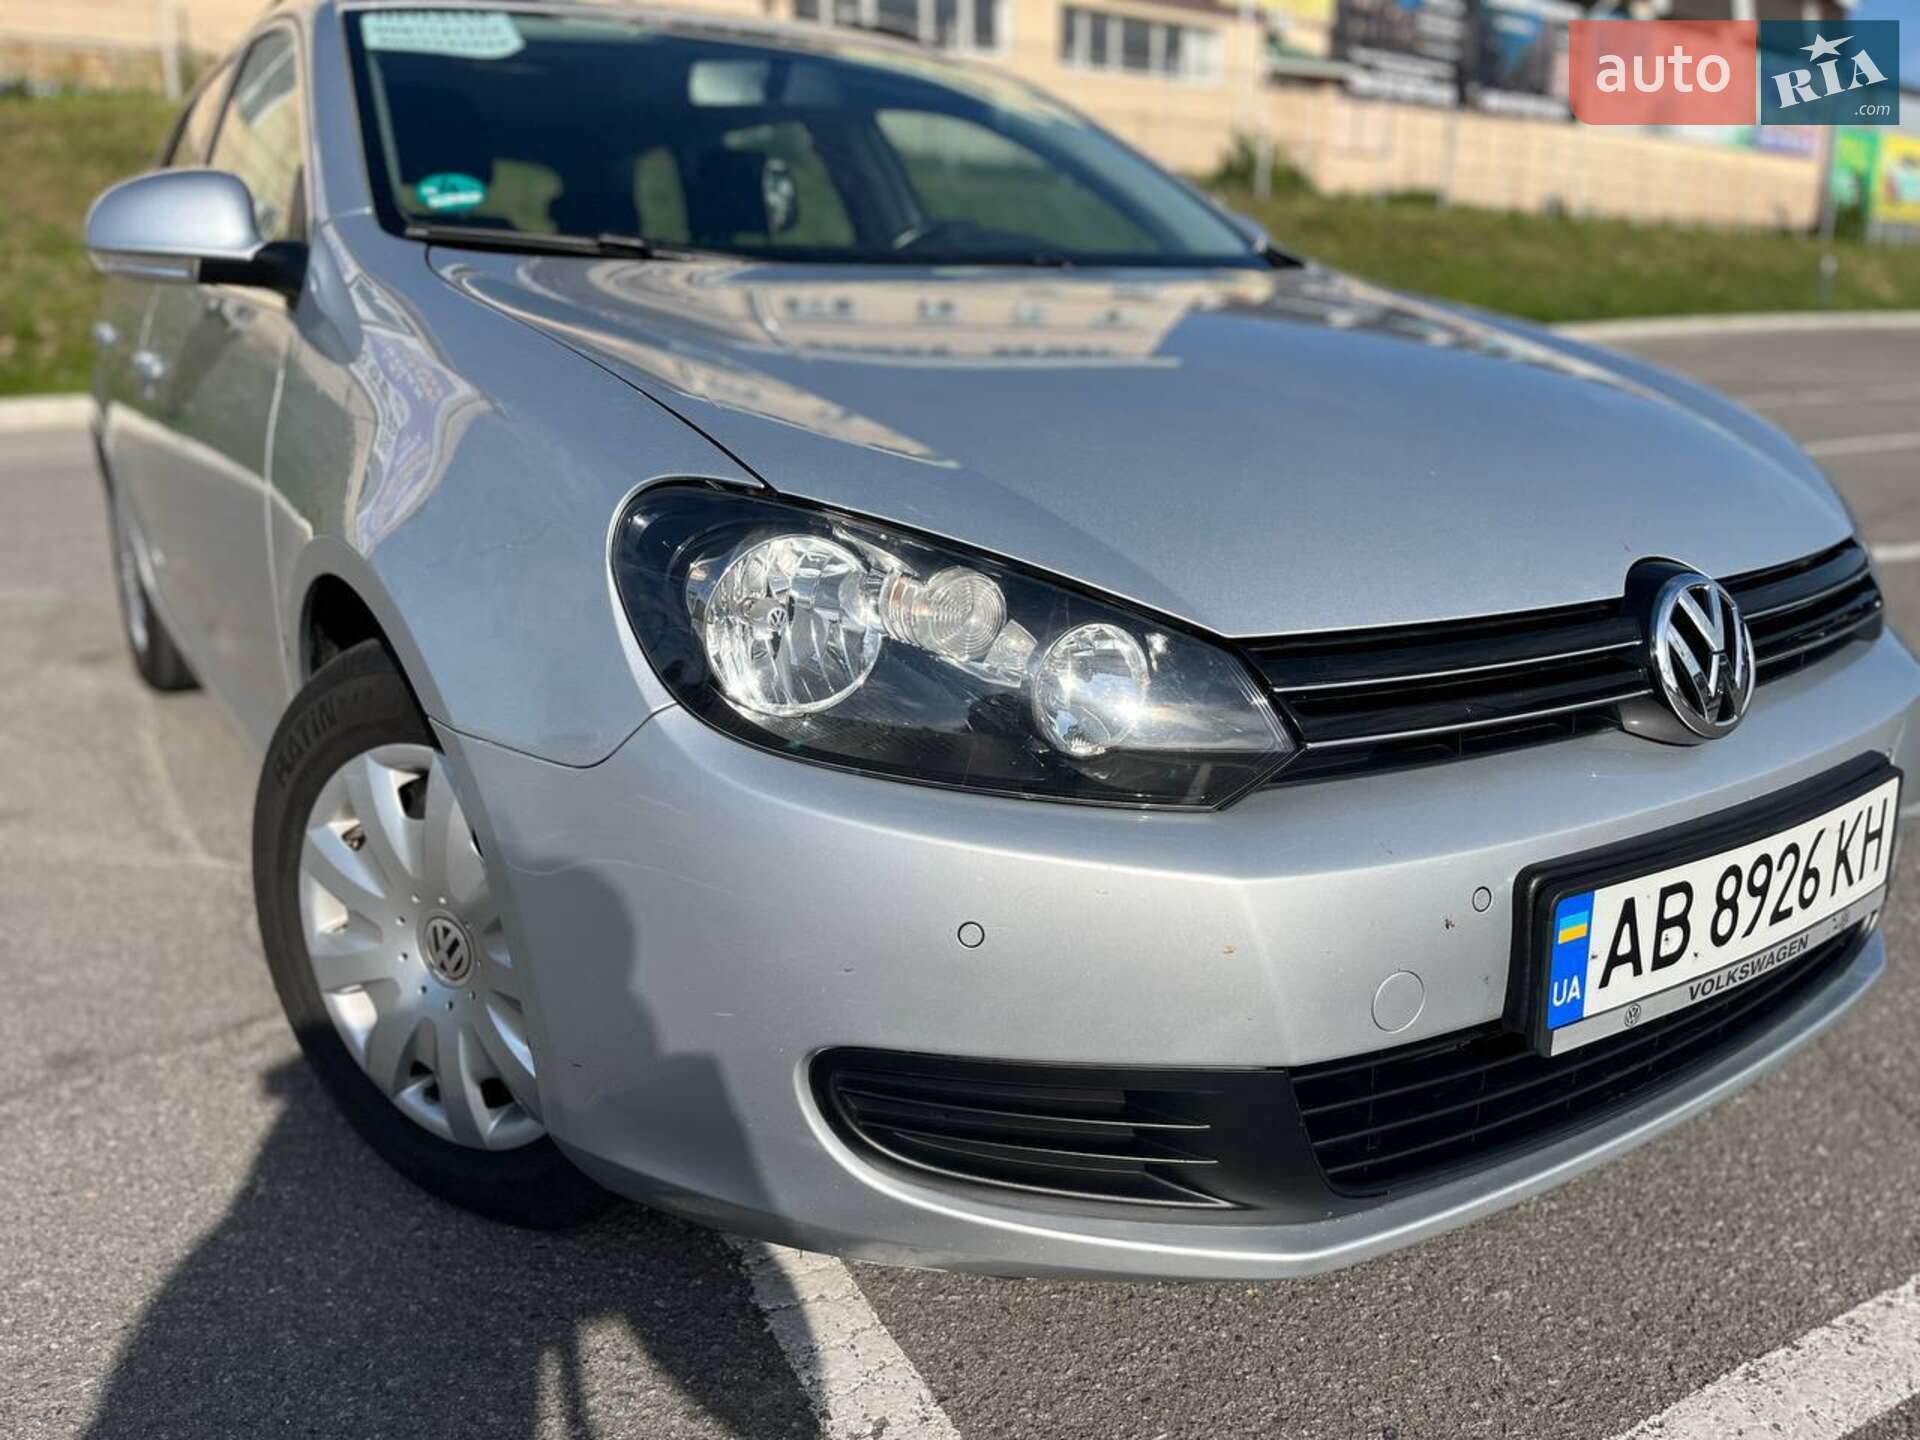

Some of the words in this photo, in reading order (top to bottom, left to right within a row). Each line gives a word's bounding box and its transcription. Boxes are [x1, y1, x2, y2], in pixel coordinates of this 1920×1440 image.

[1598, 880, 1694, 989] AB
[1710, 827, 1826, 948] 8926
[1830, 798, 1888, 897] KH
[1553, 975, 1581, 1007] UA
[1689, 934, 1808, 1001] VOLKSWAGEN
